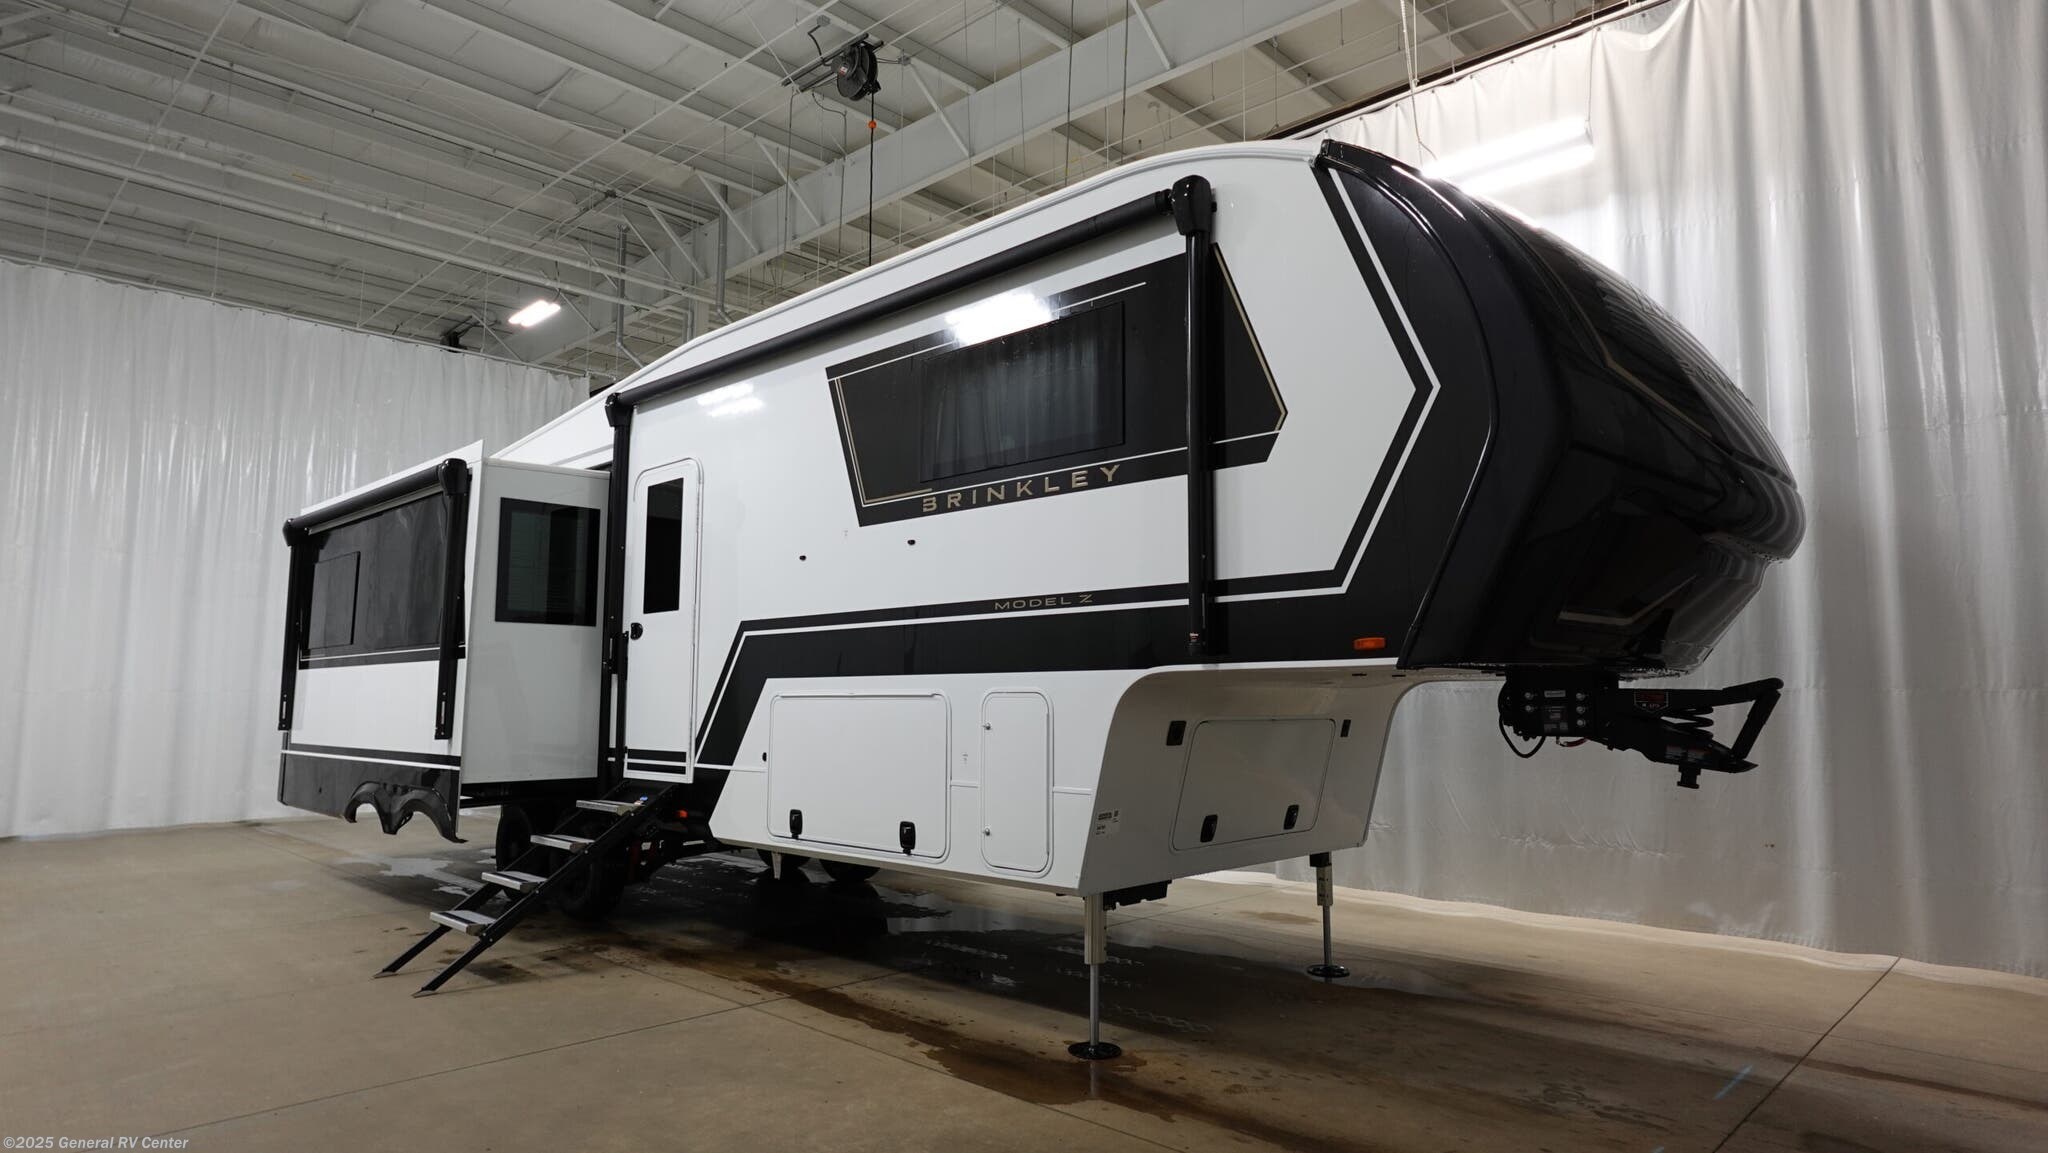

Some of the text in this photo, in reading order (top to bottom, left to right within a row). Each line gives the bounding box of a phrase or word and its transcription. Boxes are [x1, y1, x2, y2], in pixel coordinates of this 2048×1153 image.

[922, 464, 1120, 512] BRINKLEY
[994, 594, 1093, 610] MODEL Z
